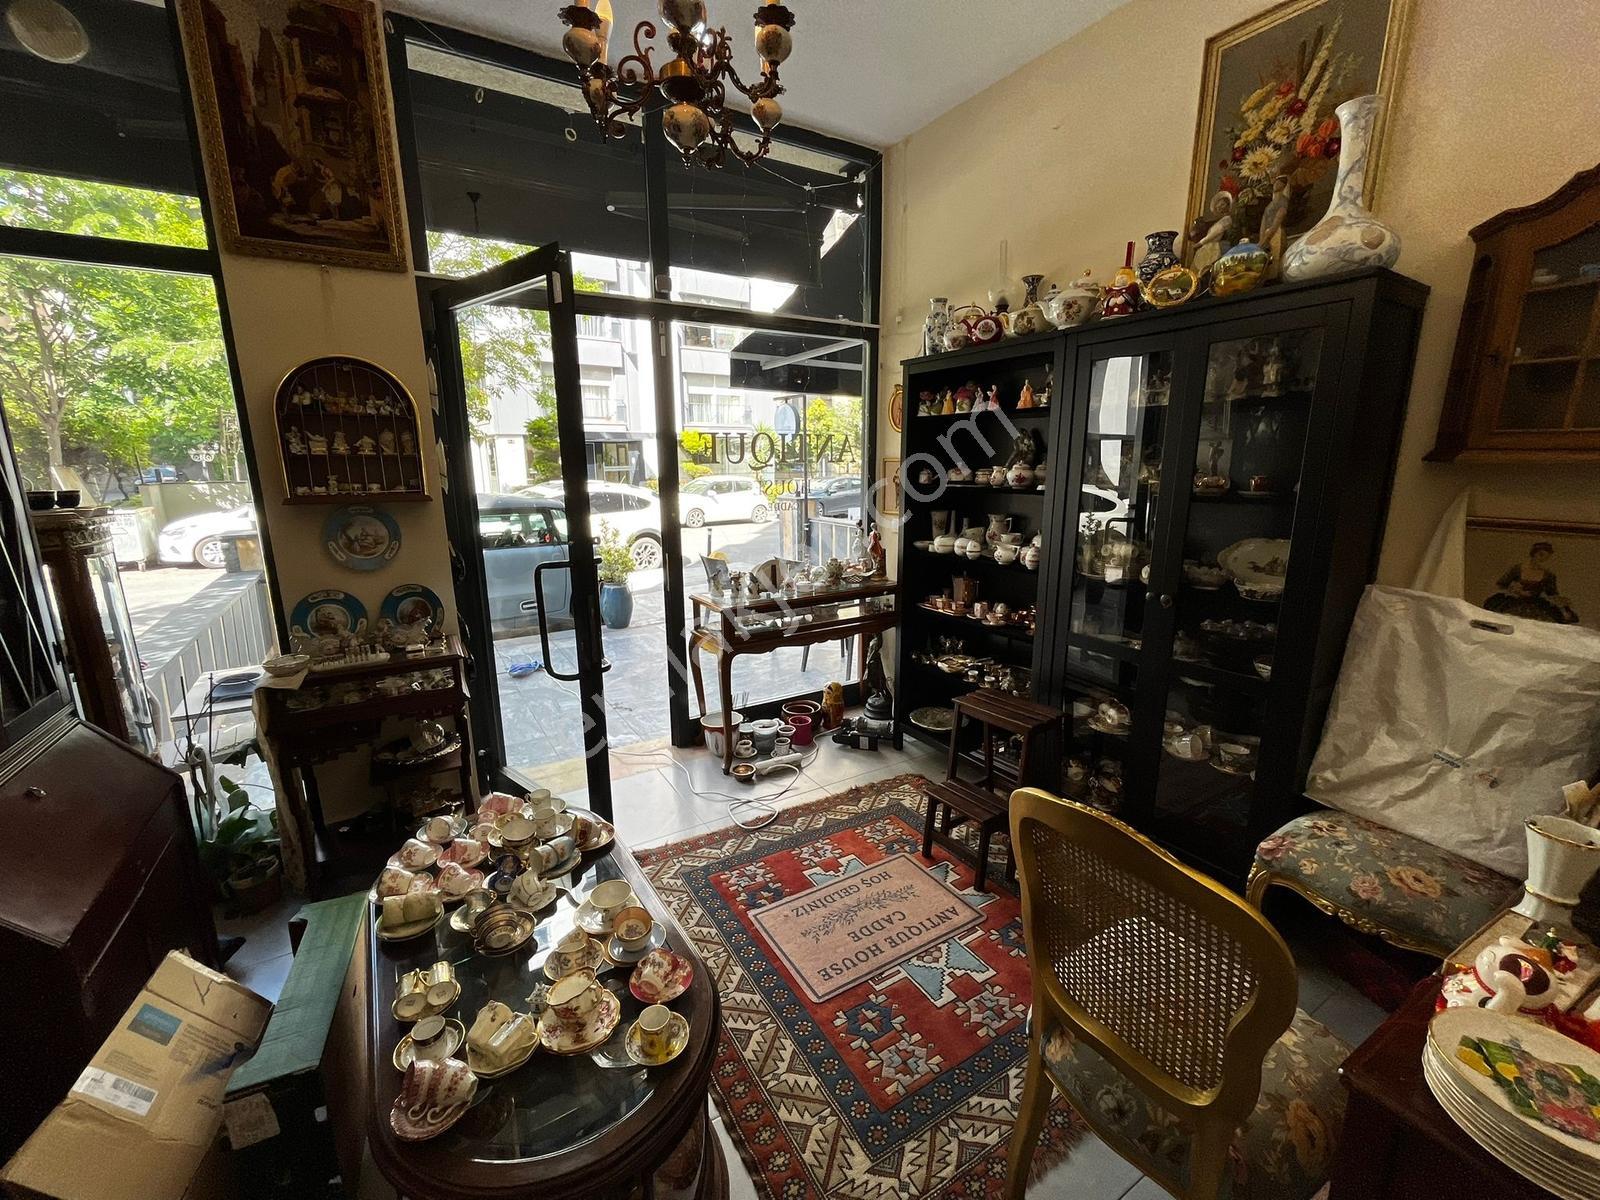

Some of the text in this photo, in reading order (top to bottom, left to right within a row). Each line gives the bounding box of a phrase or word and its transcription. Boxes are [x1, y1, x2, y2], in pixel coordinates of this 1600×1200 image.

[791, 871, 892, 918] HOŞ GELDİNİZ
[817, 906, 960, 981] ANTIQUE HOUSE
[847, 911, 906, 942] CADDE
